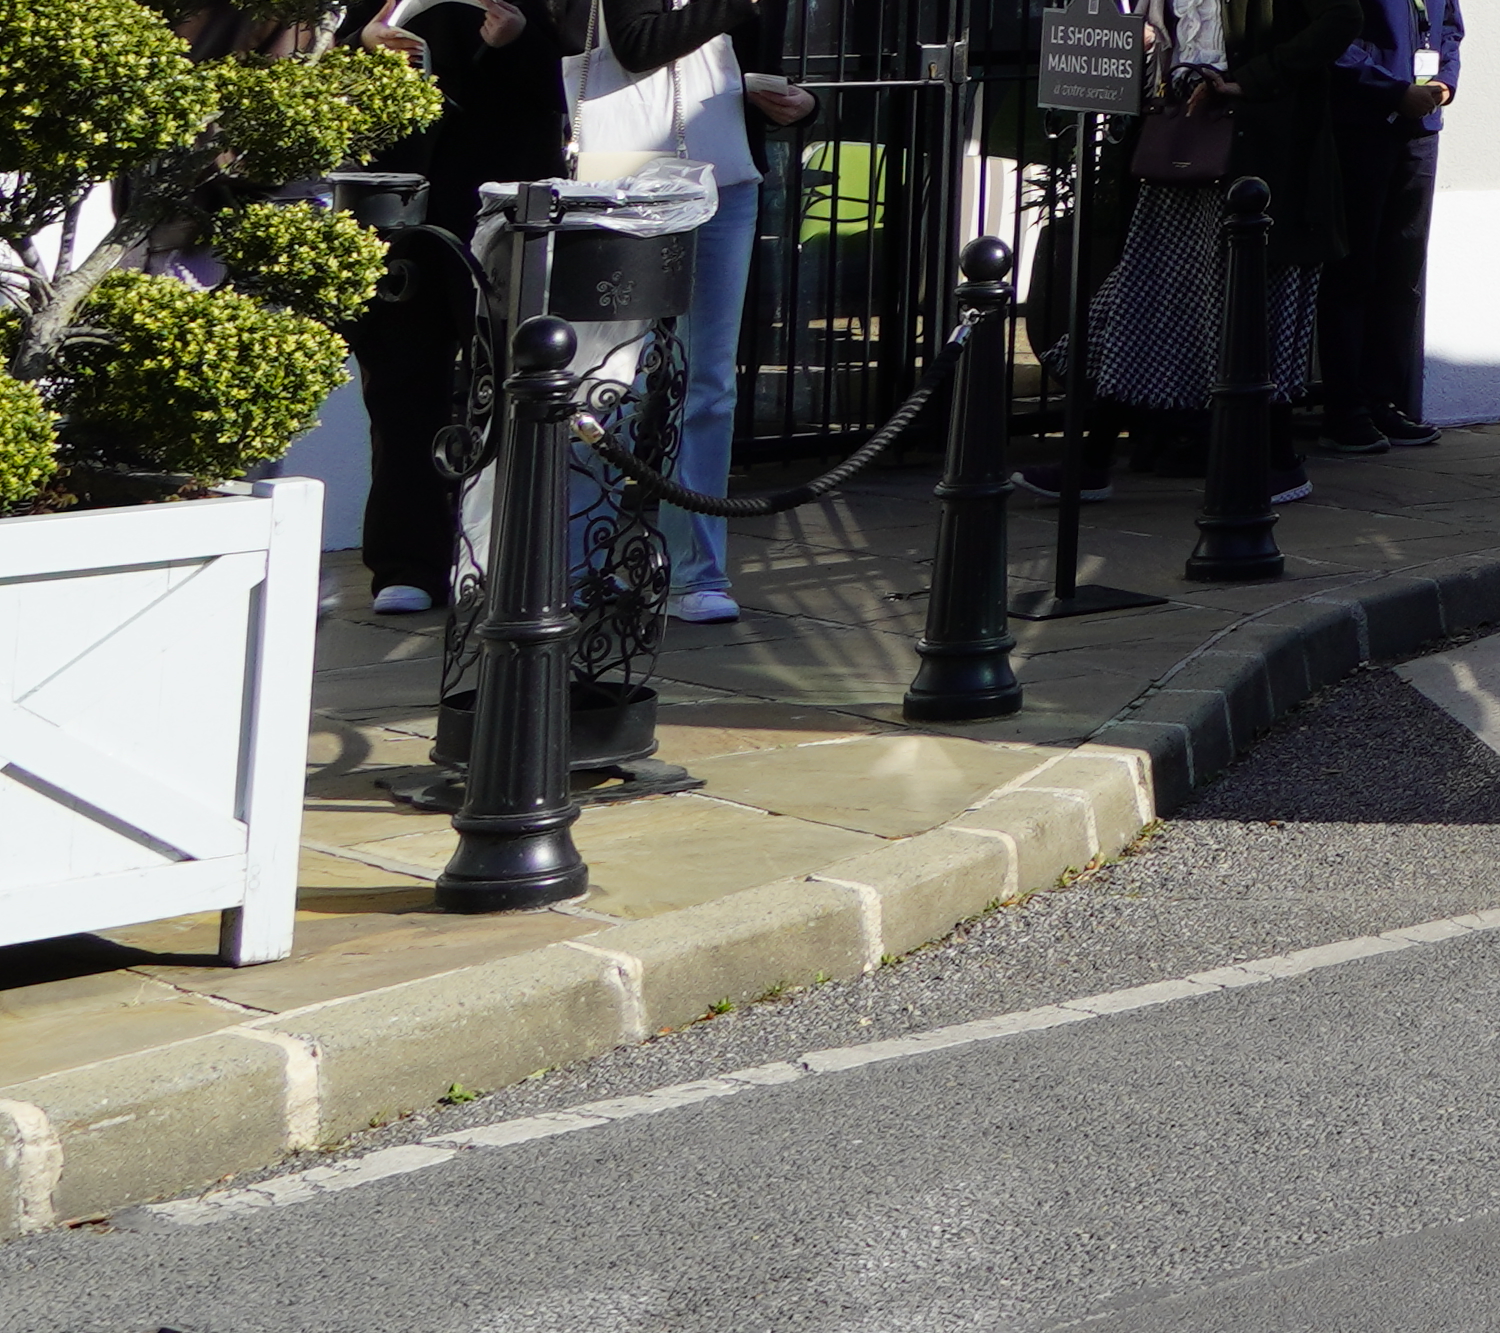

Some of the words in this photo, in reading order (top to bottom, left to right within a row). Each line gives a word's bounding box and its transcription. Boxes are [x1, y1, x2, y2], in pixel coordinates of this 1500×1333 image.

[1050, 25, 1066, 44] LE
[1067, 26, 1134, 50] SHOPPING
[1048, 52, 1088, 75] MAINS
[1091, 56, 1133, 79] LIBRES
[1061, 84, 1086, 97] votre
[1086, 85, 1118, 101] service
